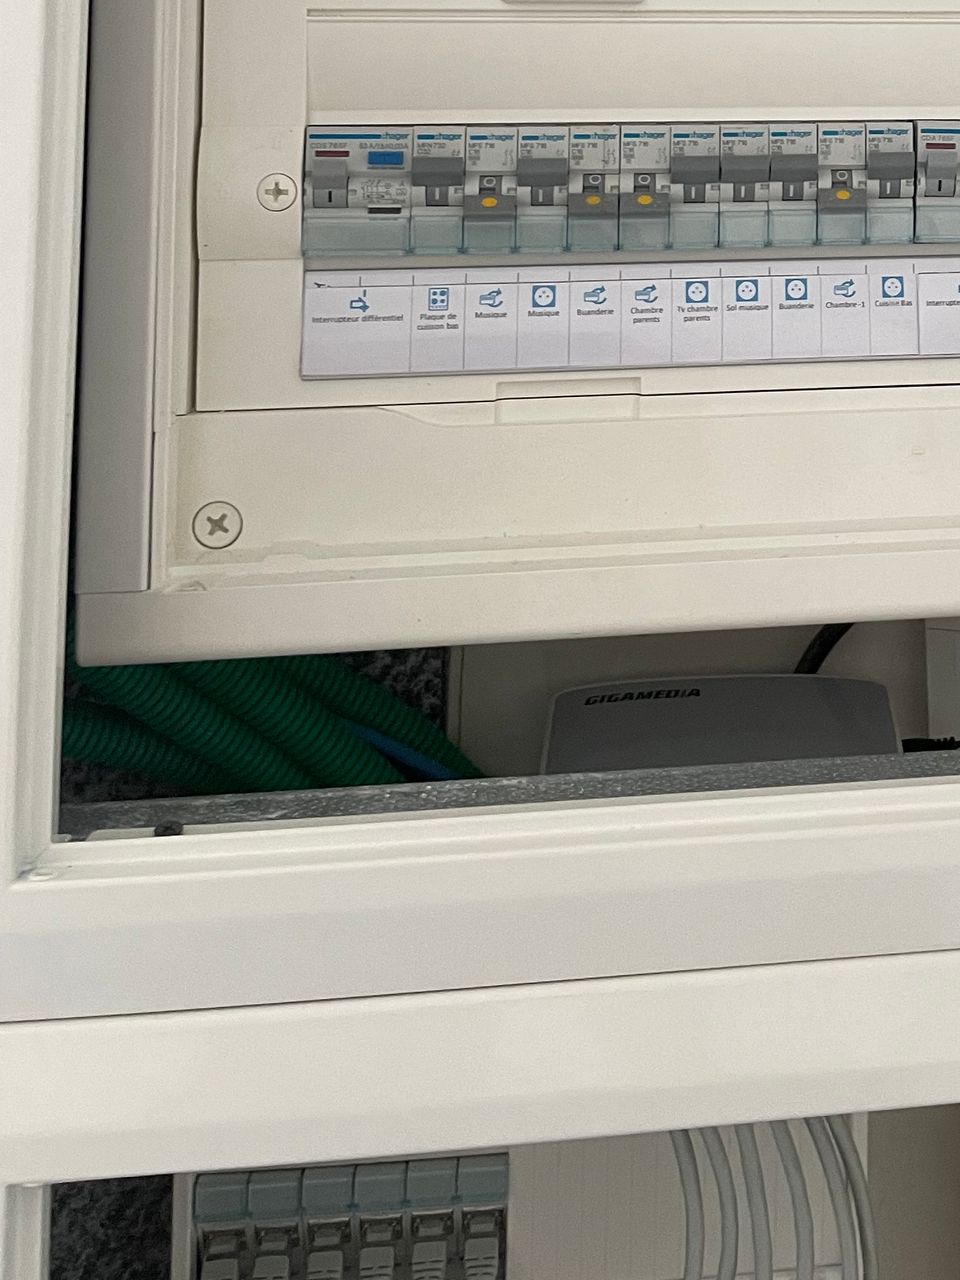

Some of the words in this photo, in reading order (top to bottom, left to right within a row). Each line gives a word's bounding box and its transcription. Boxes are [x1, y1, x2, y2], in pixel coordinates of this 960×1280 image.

[726, 304, 737, 312] Sol
[779, 302, 815, 311] Buanderie
[825, 300, 858, 308] Chambre
[527, 309, 560, 317] Musique
[576, 307, 614, 316] Buanderie
[630, 307, 664, 315] Chambre
[686, 305, 718, 313] chambre
[420, 313, 445, 321] Plaque
[475, 310, 508, 318] Musique
[312, 316, 359, 324] Interrupteur
[361, 314, 404, 322] différentiel
[633, 316, 661, 324] parents
[683, 315, 711, 323] parents
[583, 688, 701, 706] GIGAMEDIA
